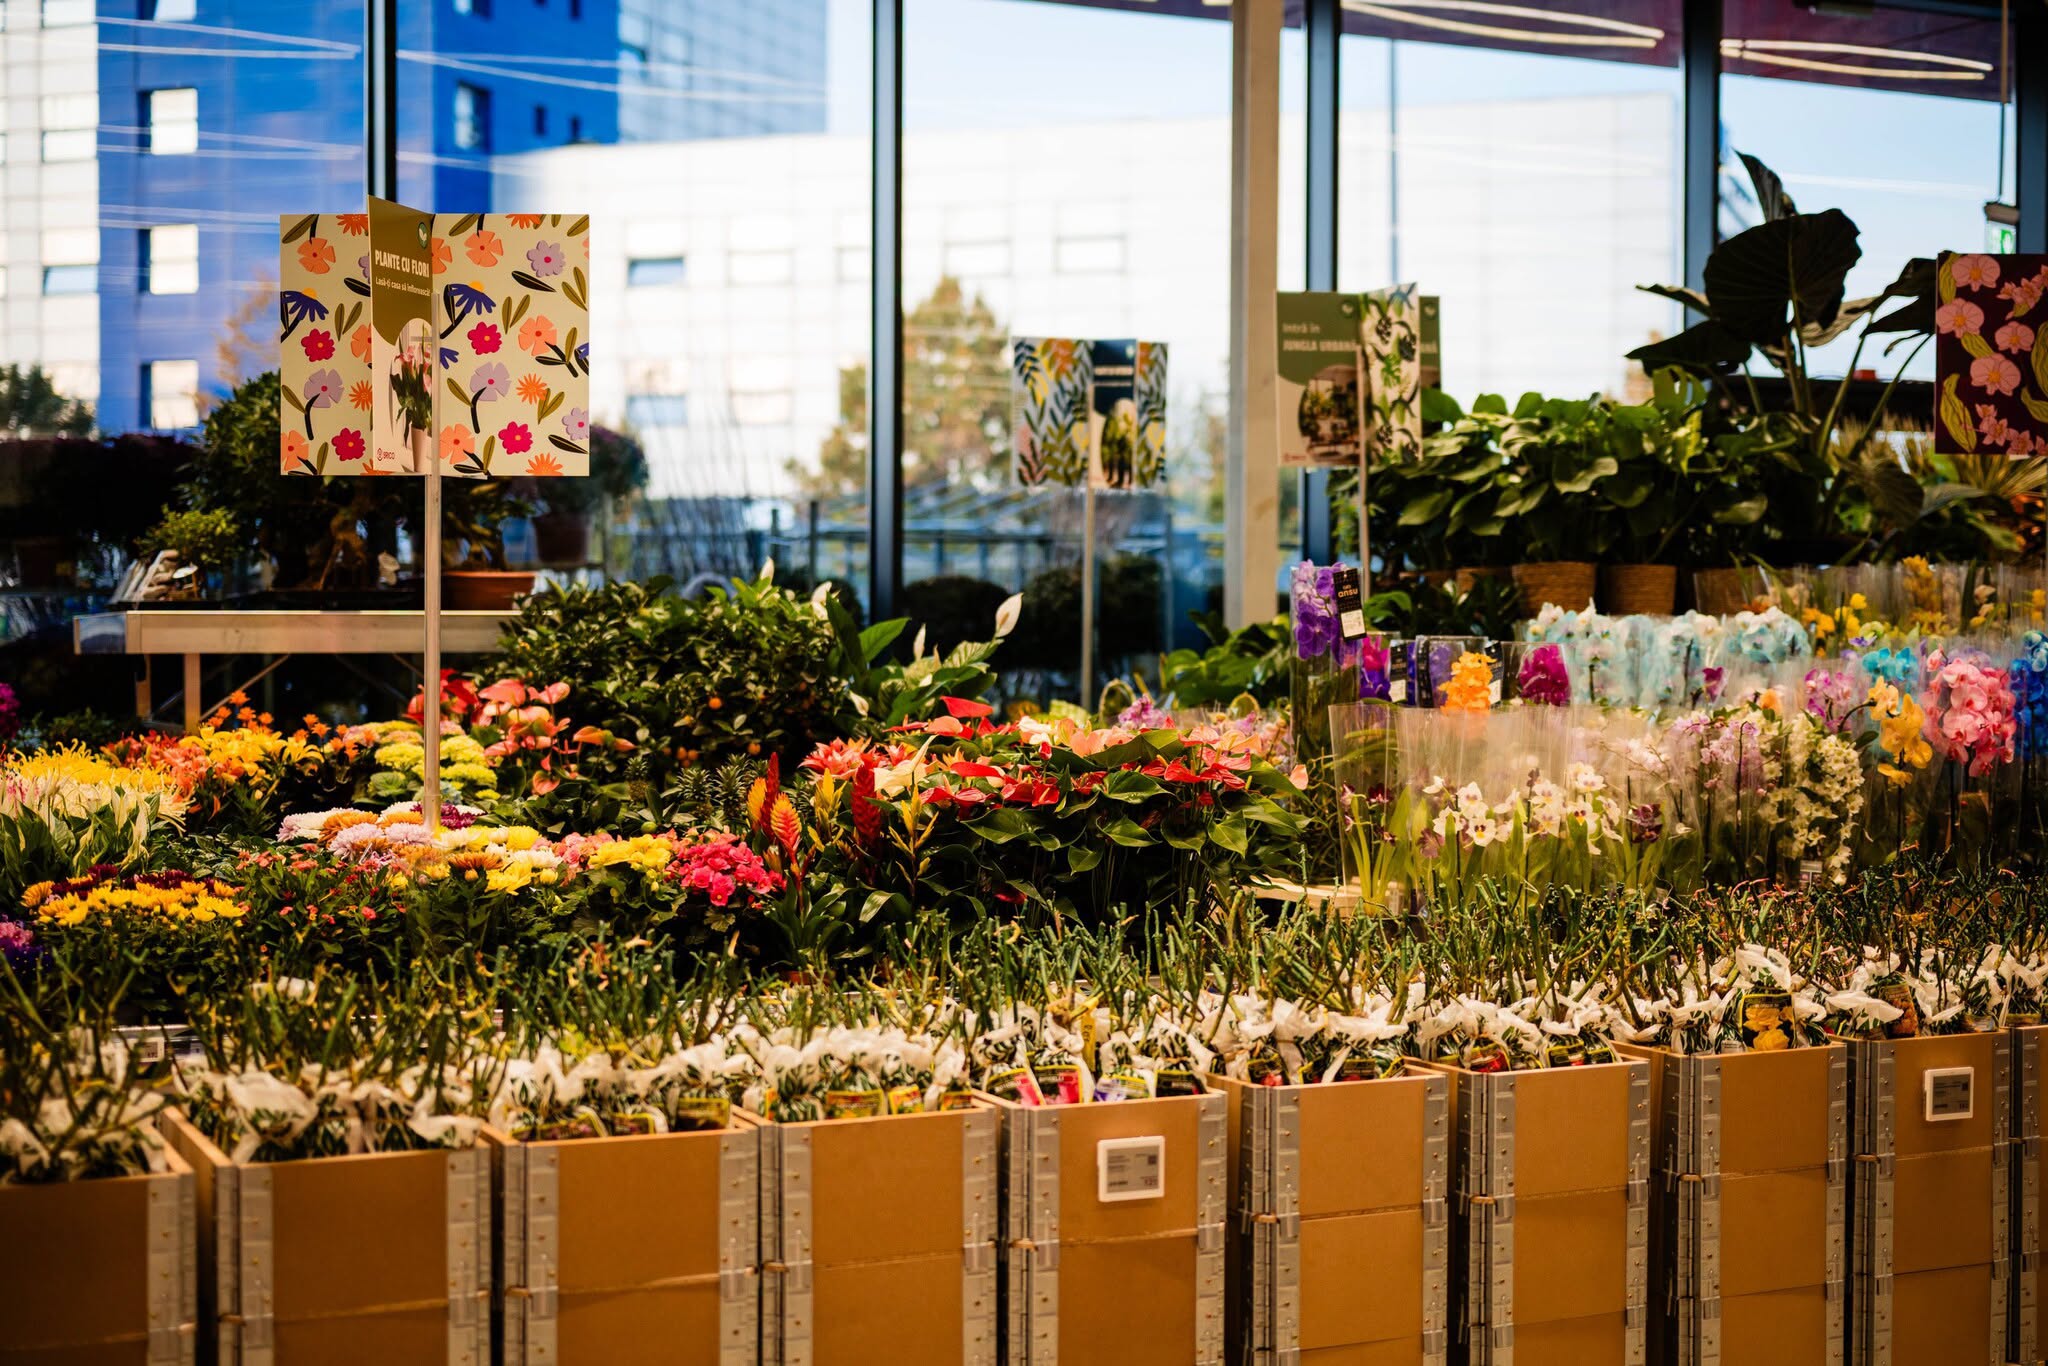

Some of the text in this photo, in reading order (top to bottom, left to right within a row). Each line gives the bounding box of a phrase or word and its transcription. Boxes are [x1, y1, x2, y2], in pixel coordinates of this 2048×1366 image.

[375, 249, 430, 278] PLANTE CU FLORI
[391, 281, 401, 290] casa
[401, 282, 407, 291] să
[1337, 588, 1358, 598] ansu
